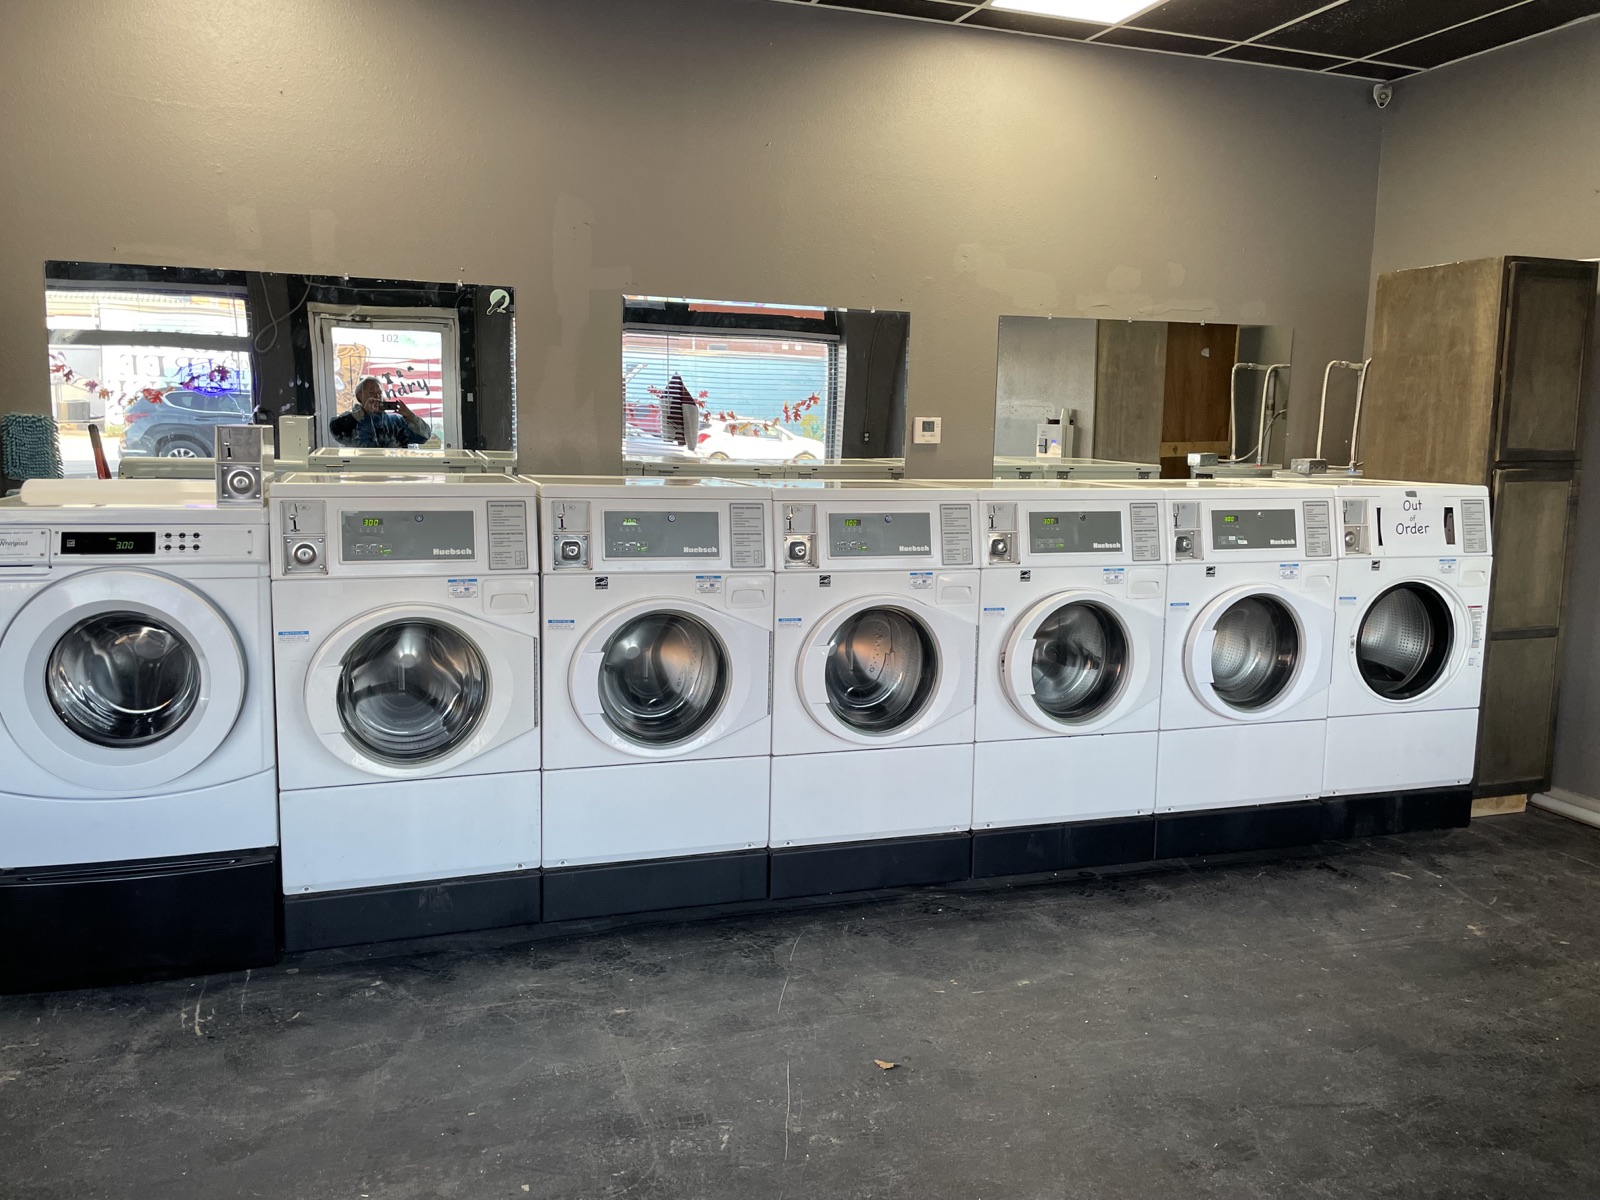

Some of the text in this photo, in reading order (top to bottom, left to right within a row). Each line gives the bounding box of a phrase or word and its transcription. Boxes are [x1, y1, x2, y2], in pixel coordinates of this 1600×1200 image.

[381, 333, 399, 343] 102
[384, 379, 431, 400] ndry
[1402, 499, 1423, 511] Out
[1409, 514, 1417, 522] of
[1395, 522, 1430, 535] Order
[432, 548, 472, 556] Huebsch
